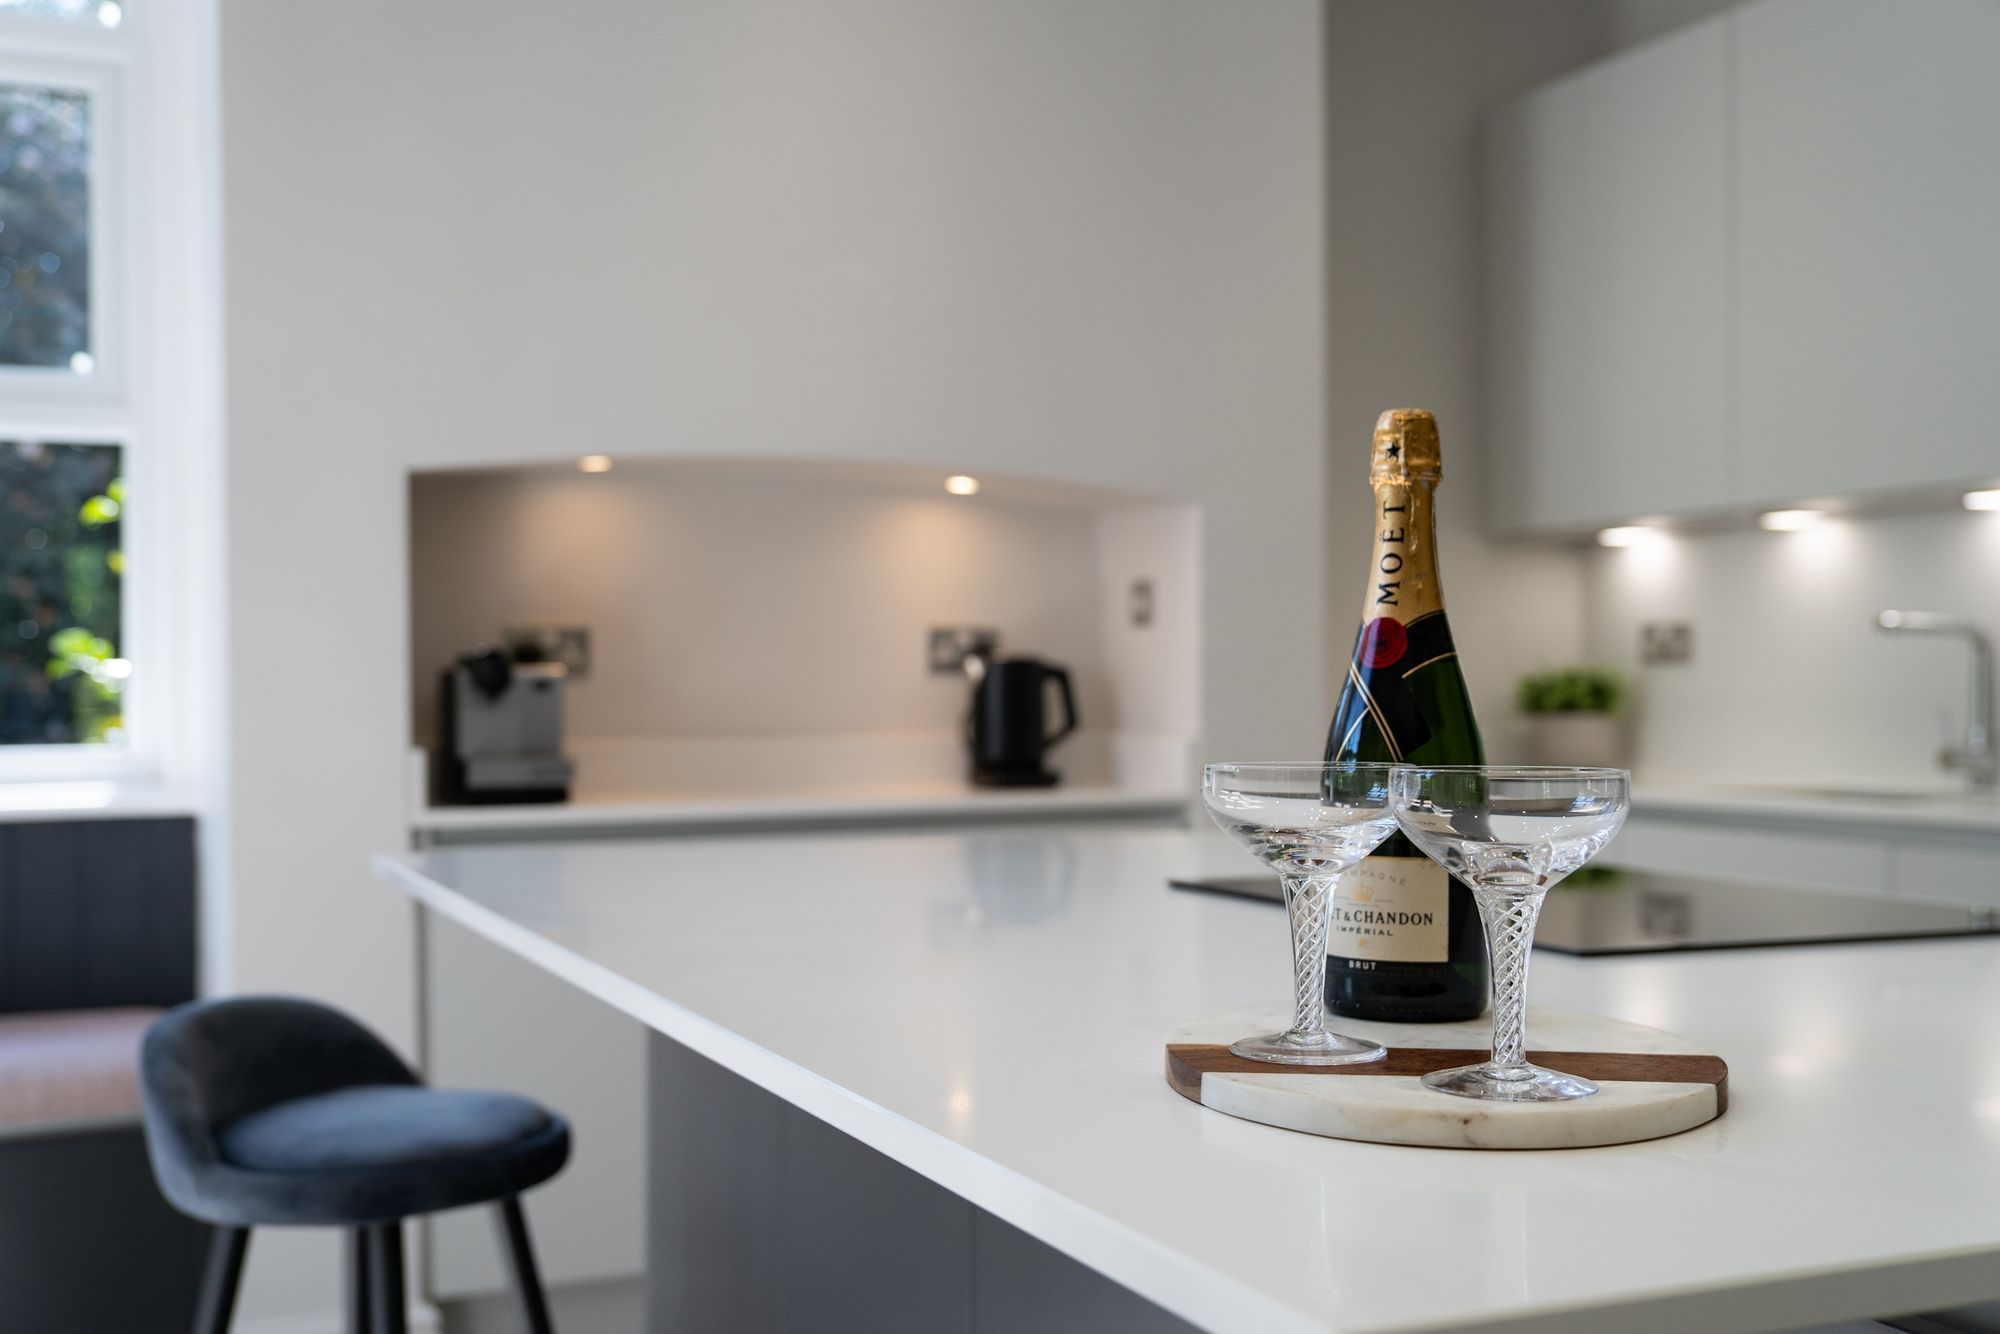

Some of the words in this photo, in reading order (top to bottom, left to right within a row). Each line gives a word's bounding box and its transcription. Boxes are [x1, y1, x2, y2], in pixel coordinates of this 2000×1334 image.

[1376, 500, 1405, 606] MOËT
[1343, 911, 1352, 922] &
[1353, 910, 1434, 927] CHANDON
[1336, 926, 1394, 937] IMPÉRIAL
[1349, 960, 1377, 971] BRUT
